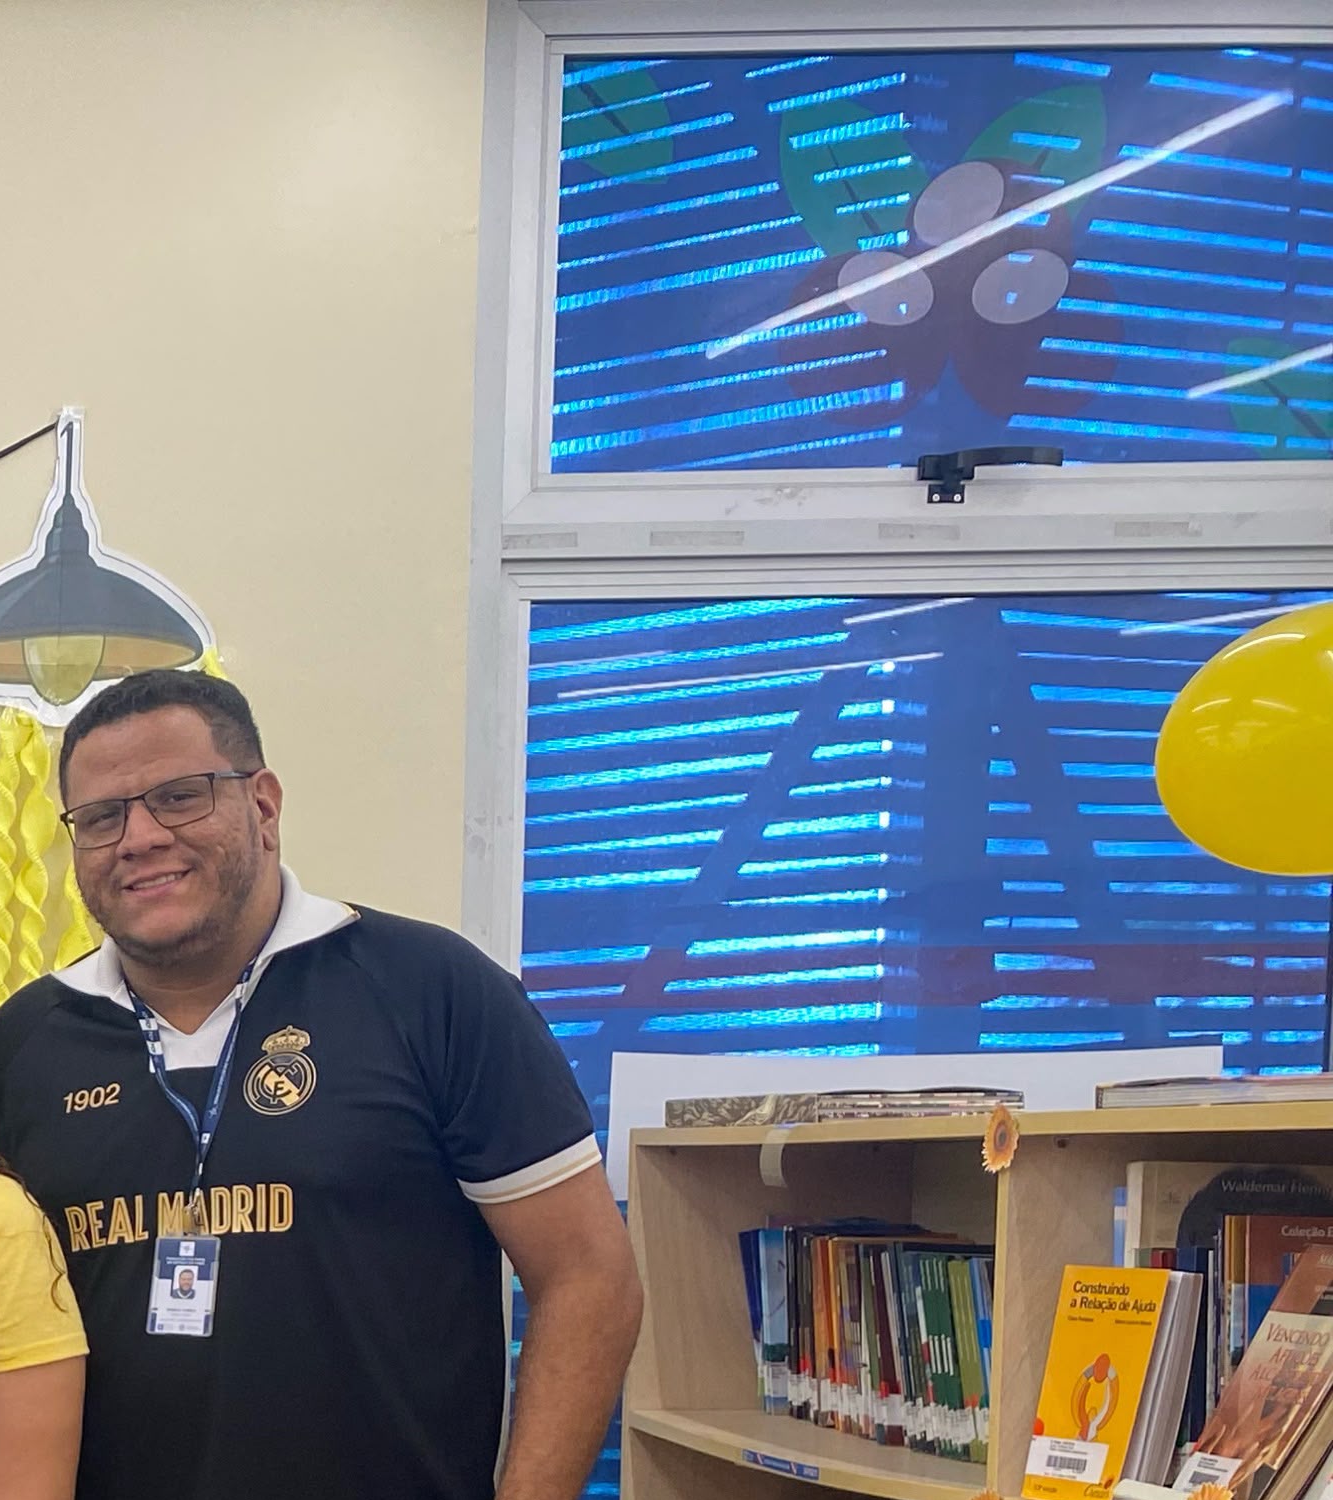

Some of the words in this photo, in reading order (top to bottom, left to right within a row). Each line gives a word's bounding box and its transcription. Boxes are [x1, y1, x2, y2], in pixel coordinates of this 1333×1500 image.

[63, 1083, 121, 1114] 1902
[65, 1194, 150, 1253] REAL
[157, 1183, 295, 1236] MADRID
[1073, 1280, 1130, 1296] Construindo
[1070, 1299, 1077, 1308] a
[1080, 1296, 1116, 1313] Relação
[1118, 1298, 1131, 1311] de
[1131, 1299, 1156, 1314] Ajuda
